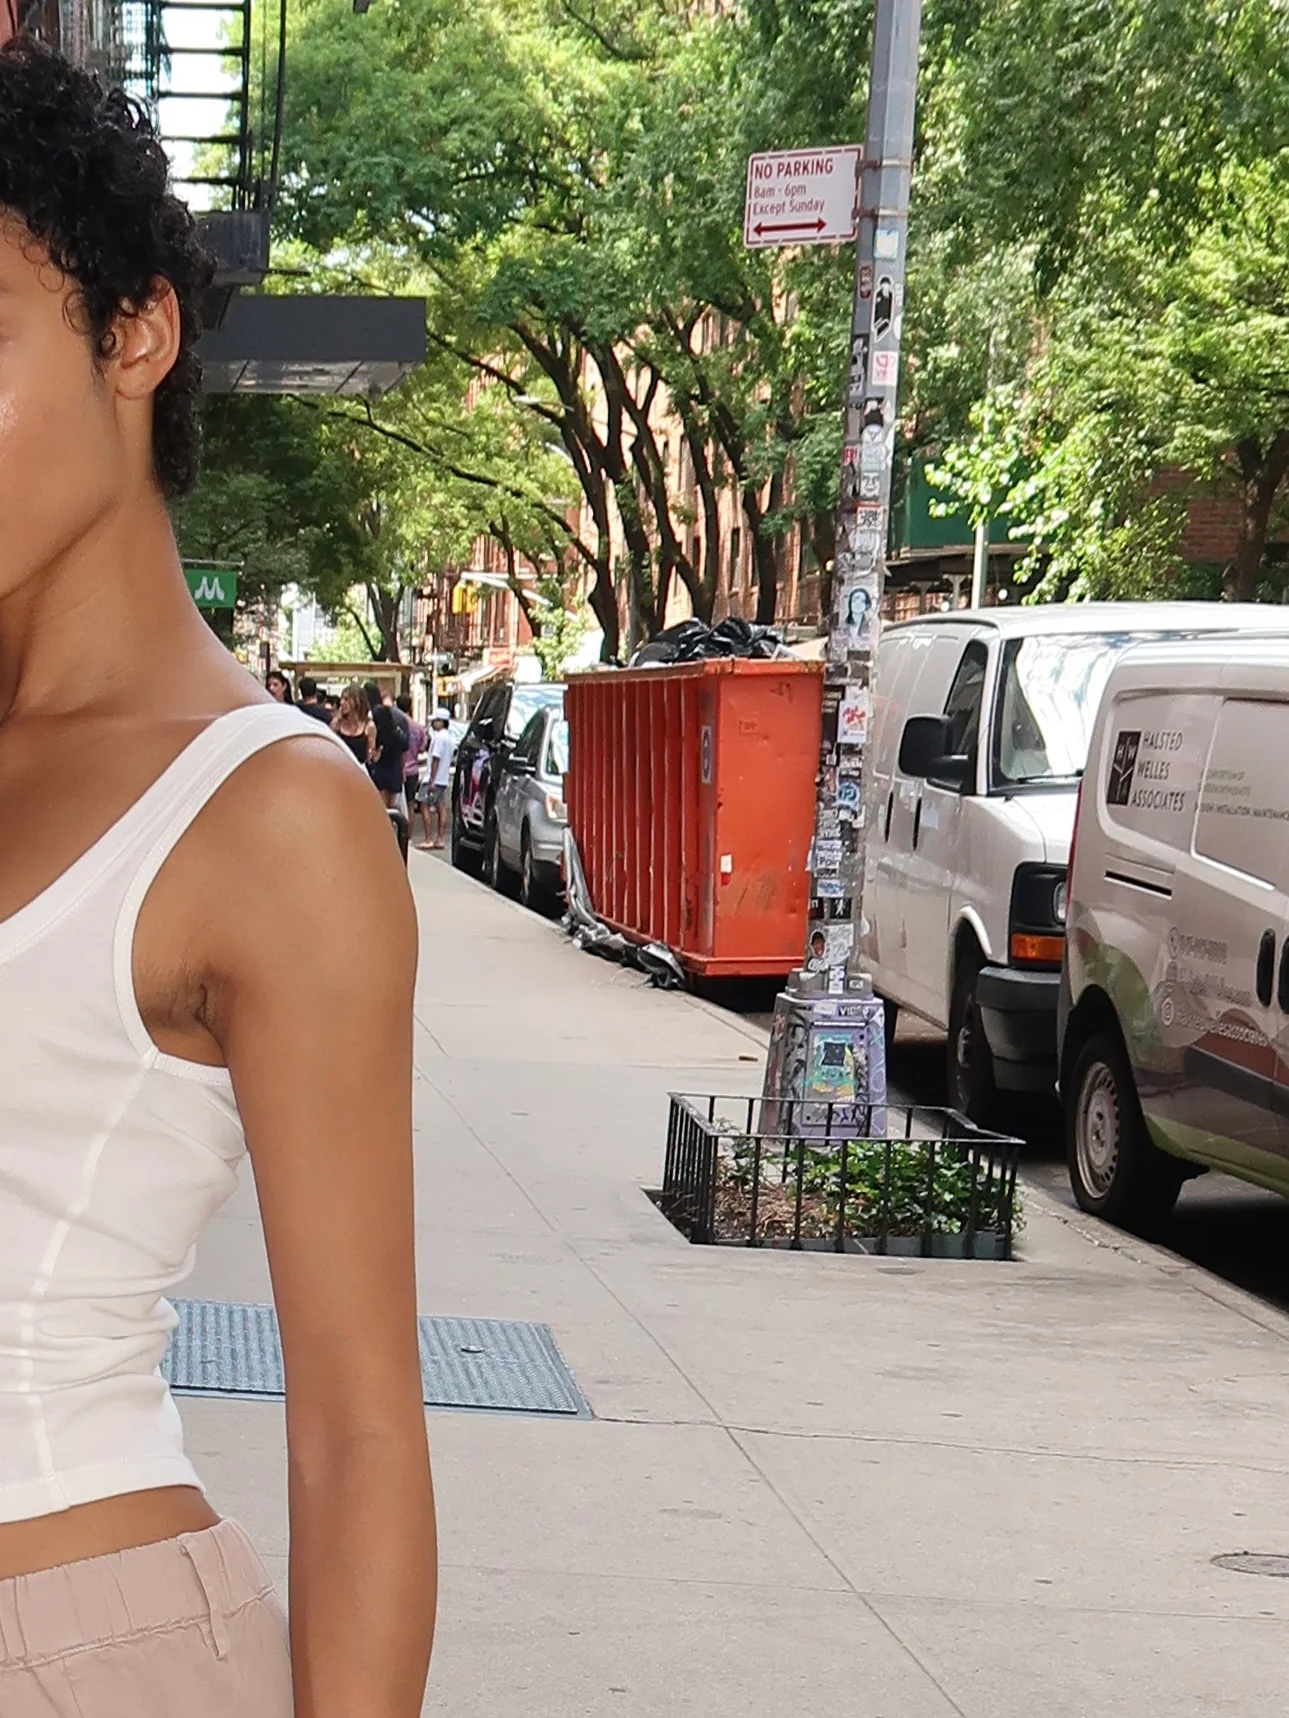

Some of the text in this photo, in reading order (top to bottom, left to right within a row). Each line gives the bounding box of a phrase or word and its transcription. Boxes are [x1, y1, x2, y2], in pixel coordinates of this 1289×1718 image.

[755, 158, 833, 180] NO PARKING
[754, 185, 775, 199] 8am
[784, 183, 807, 199] 6pm
[753, 199, 825, 216] Except Sunday
[1143, 731, 1183, 751] HALSTED
[1137, 760, 1171, 780] WELLES
[1131, 788, 1187, 812] ASSOCIATES
